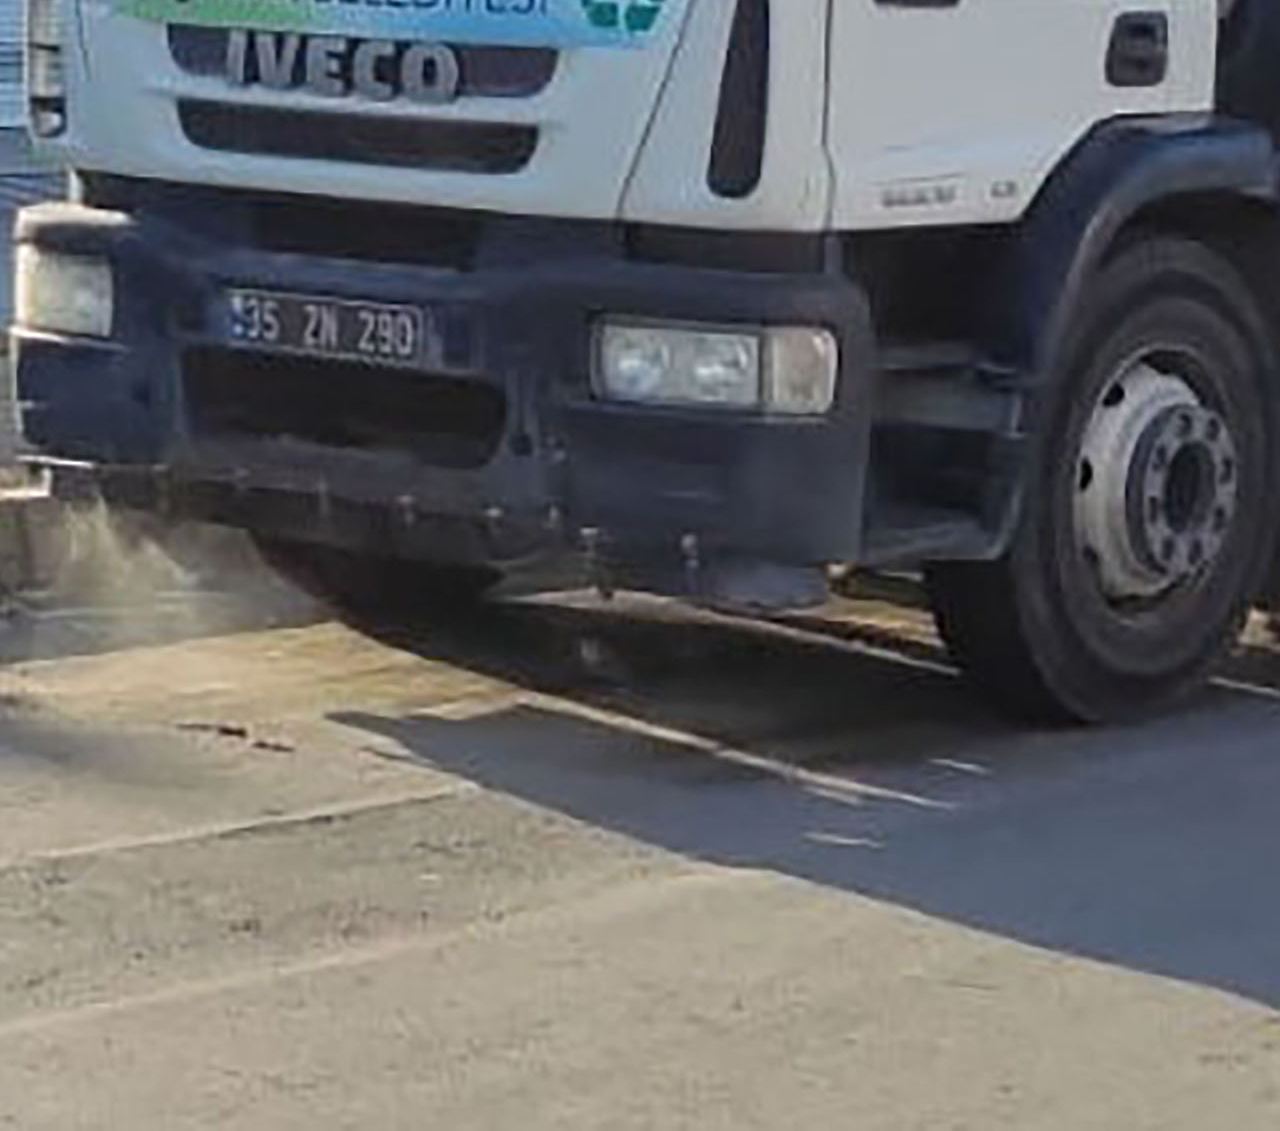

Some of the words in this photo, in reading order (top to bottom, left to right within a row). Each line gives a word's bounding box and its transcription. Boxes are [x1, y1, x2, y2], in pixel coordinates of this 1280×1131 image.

[226, 29, 460, 105] IVECO
[246, 300, 280, 341] 35
[303, 304, 338, 347] ZN
[357, 310, 414, 355] 290
